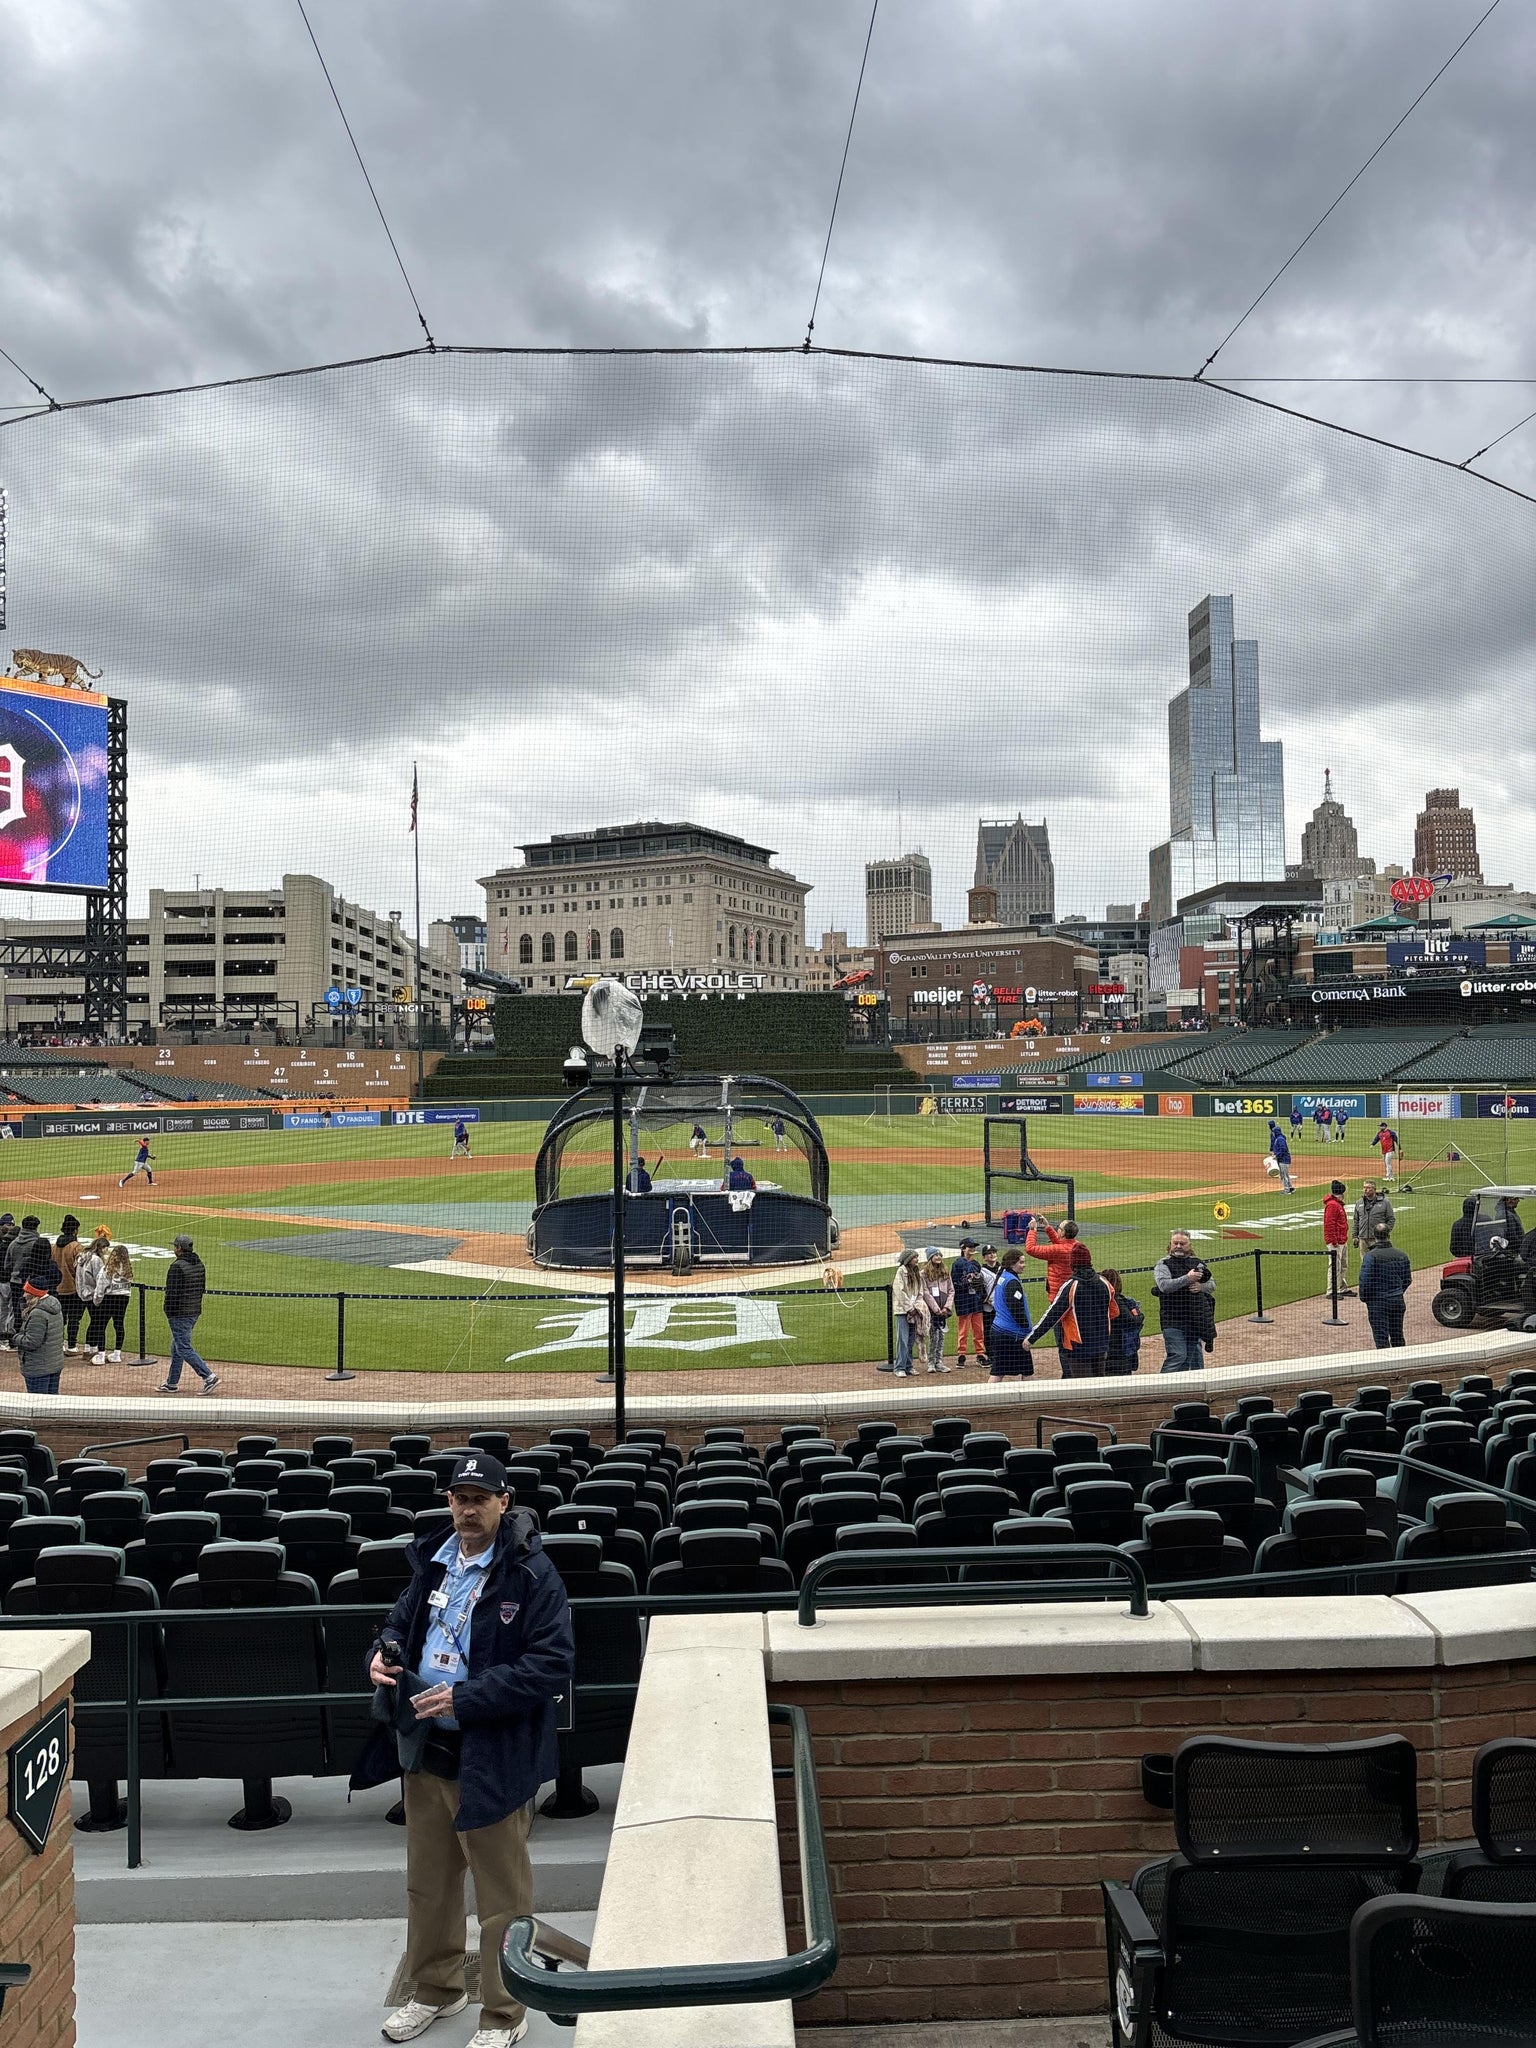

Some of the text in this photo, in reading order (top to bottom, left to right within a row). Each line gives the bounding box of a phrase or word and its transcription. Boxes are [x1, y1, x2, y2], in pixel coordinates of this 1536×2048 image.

[1394, 879, 1431, 900] AAA
[1424, 939, 1450, 955] Lite
[900, 948, 1021, 962] GRAND VALLEY STATE UNIVERSITY
[627, 974, 767, 990] CHEVROLET
[993, 987, 1022, 995] BELLE
[1088, 984, 1125, 994] FIEGER
[1373, 985, 1407, 998] Bank
[858, 994, 877, 1005] 0:08
[914, 987, 963, 1005] meijer
[997, 995, 1018, 1003] TIRE
[1101, 994, 1125, 1004] LAW
[380, 1004, 424, 1013] BETMGM
[466, 999, 486, 1010] 0:08
[1063, 1037, 1072, 1046] 11
[1100, 1036, 1111, 1044] 42
[1025, 1041, 1035, 1050] 10
[159, 1049, 171, 1058] 23
[253, 1048, 260, 1057] 5
[300, 1050, 307, 1059] 2
[346, 1051, 355, 1060] 16
[395, 1053, 401, 1062] 6
[274, 1067, 286, 1076] 47
[323, 1069, 329, 1078] 3
[375, 1069, 379, 1079] 1
[940, 1097, 984, 1108] FERRIS
[1079, 1097, 1118, 1112] Surfside
[1168, 1099, 1182, 1113] hap
[1214, 1098, 1274, 1114] bet365
[1316, 1097, 1358, 1108] McLaren
[1398, 1098, 1442, 1115] meijer
[1490, 1104, 1529, 1116] Coona
[346, 1115, 374, 1123] FANDUEL
[396, 1111, 425, 1124] DTE
[55, 1124, 100, 1133] BETMGM
[115, 1121, 158, 1131] BETMGM
[24, 1737, 60, 1800] 128
